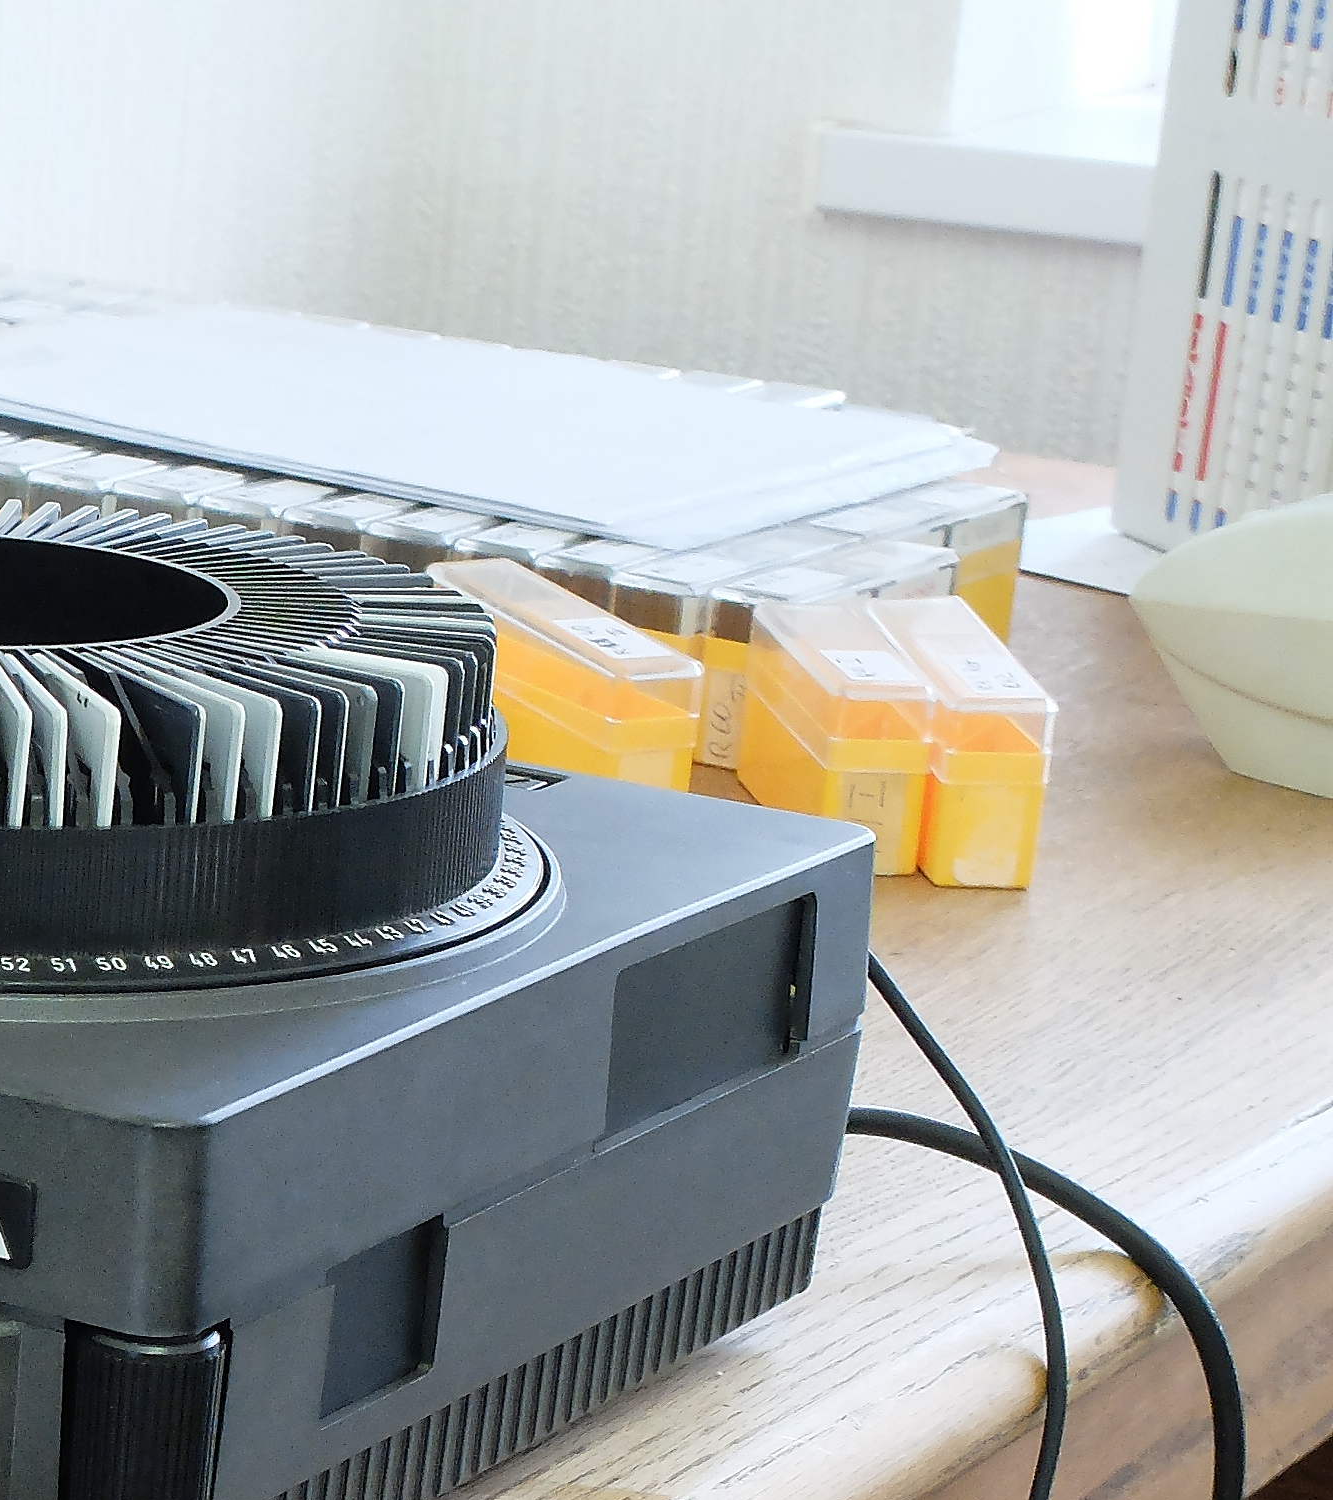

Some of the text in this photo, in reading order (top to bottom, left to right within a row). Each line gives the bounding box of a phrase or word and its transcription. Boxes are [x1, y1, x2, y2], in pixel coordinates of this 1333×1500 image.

[0, 957, 31, 973] 52
[50, 957, 77, 973] 51
[95, 957, 127, 971] 50
[144, 955, 174, 970] 49
[188, 952, 218, 968] 48
[230, 947, 257, 964] 47
[270, 944, 301, 959] 46
[308, 938, 339, 953] 45
[343, 932, 373, 947] 44
[375, 925, 405, 941] 43
[404, 918, 432, 933] 42
